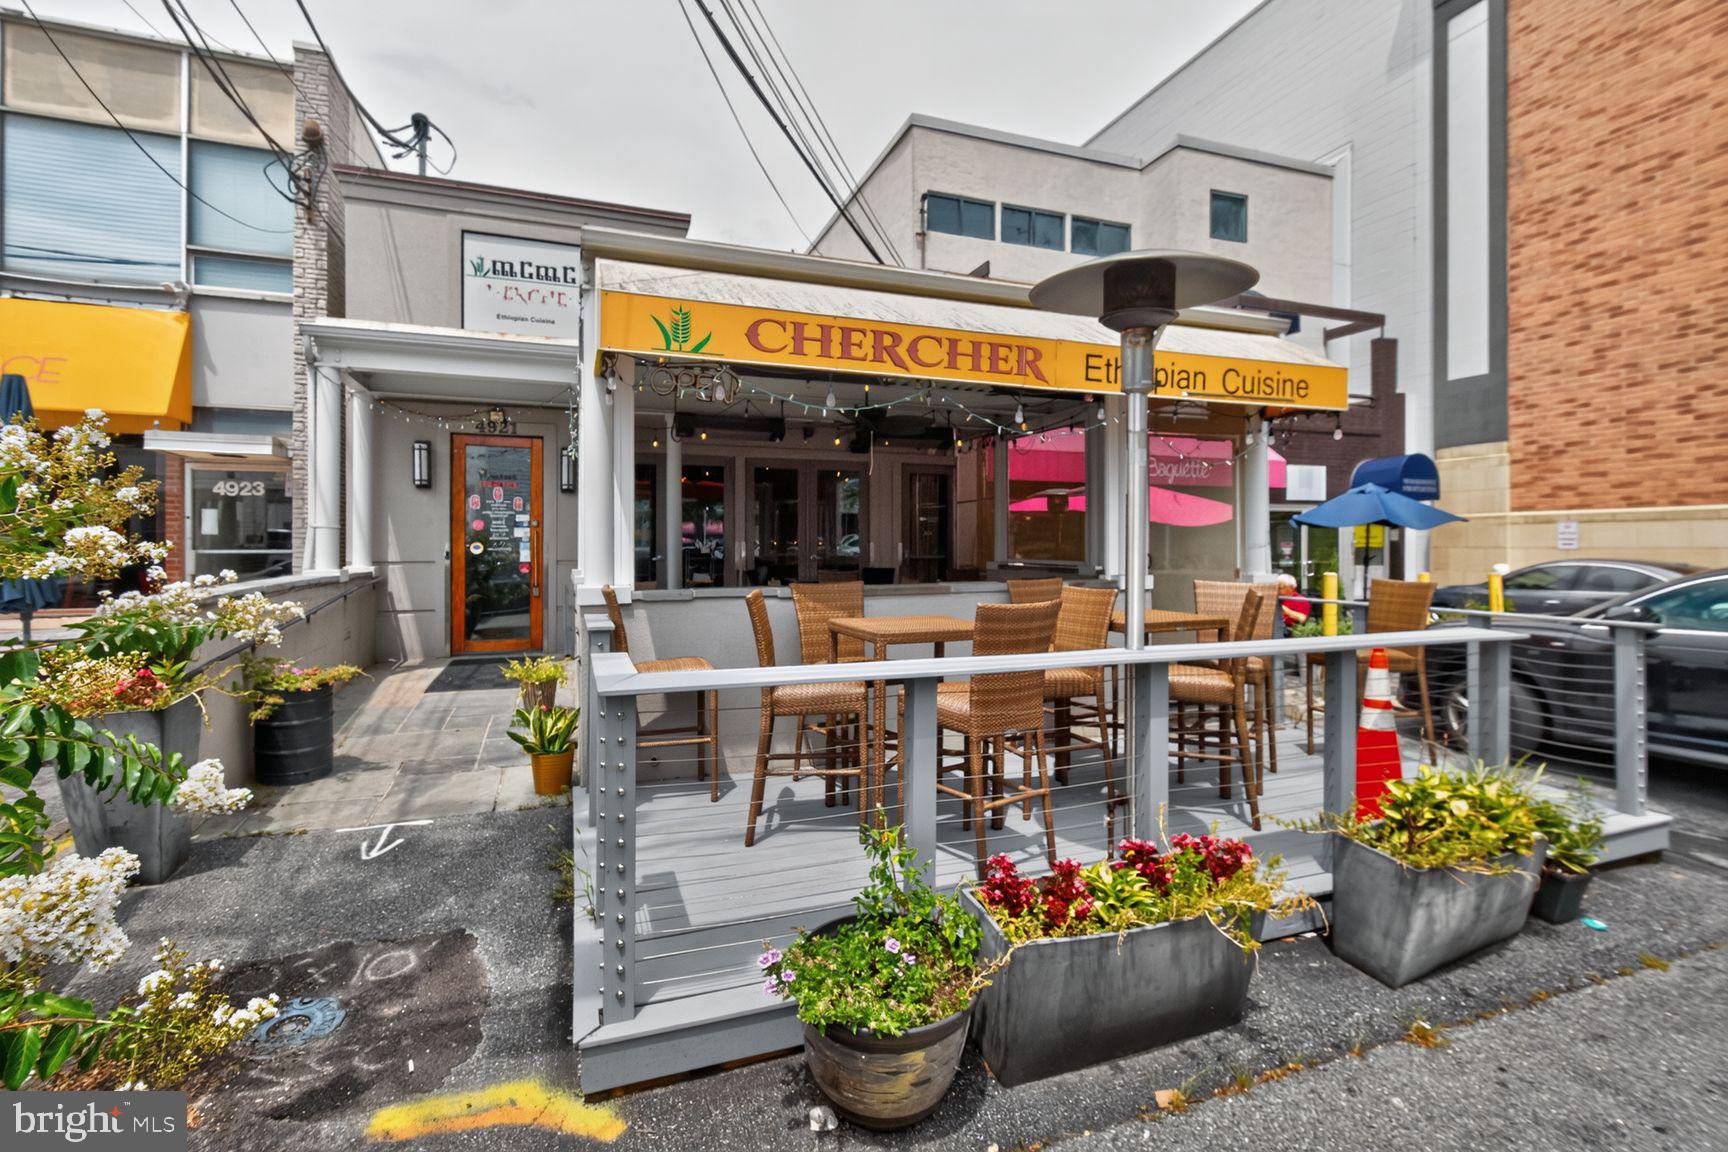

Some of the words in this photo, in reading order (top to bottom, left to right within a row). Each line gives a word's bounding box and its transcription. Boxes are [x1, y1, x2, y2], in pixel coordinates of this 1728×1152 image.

[744, 318, 1049, 384] CHERCHER
[1085, 353, 1206, 395] Ethpian
[1222, 368, 1309, 399] Cuisine
[475, 420, 517, 434] 4921
[211, 480, 265, 497] 4923
